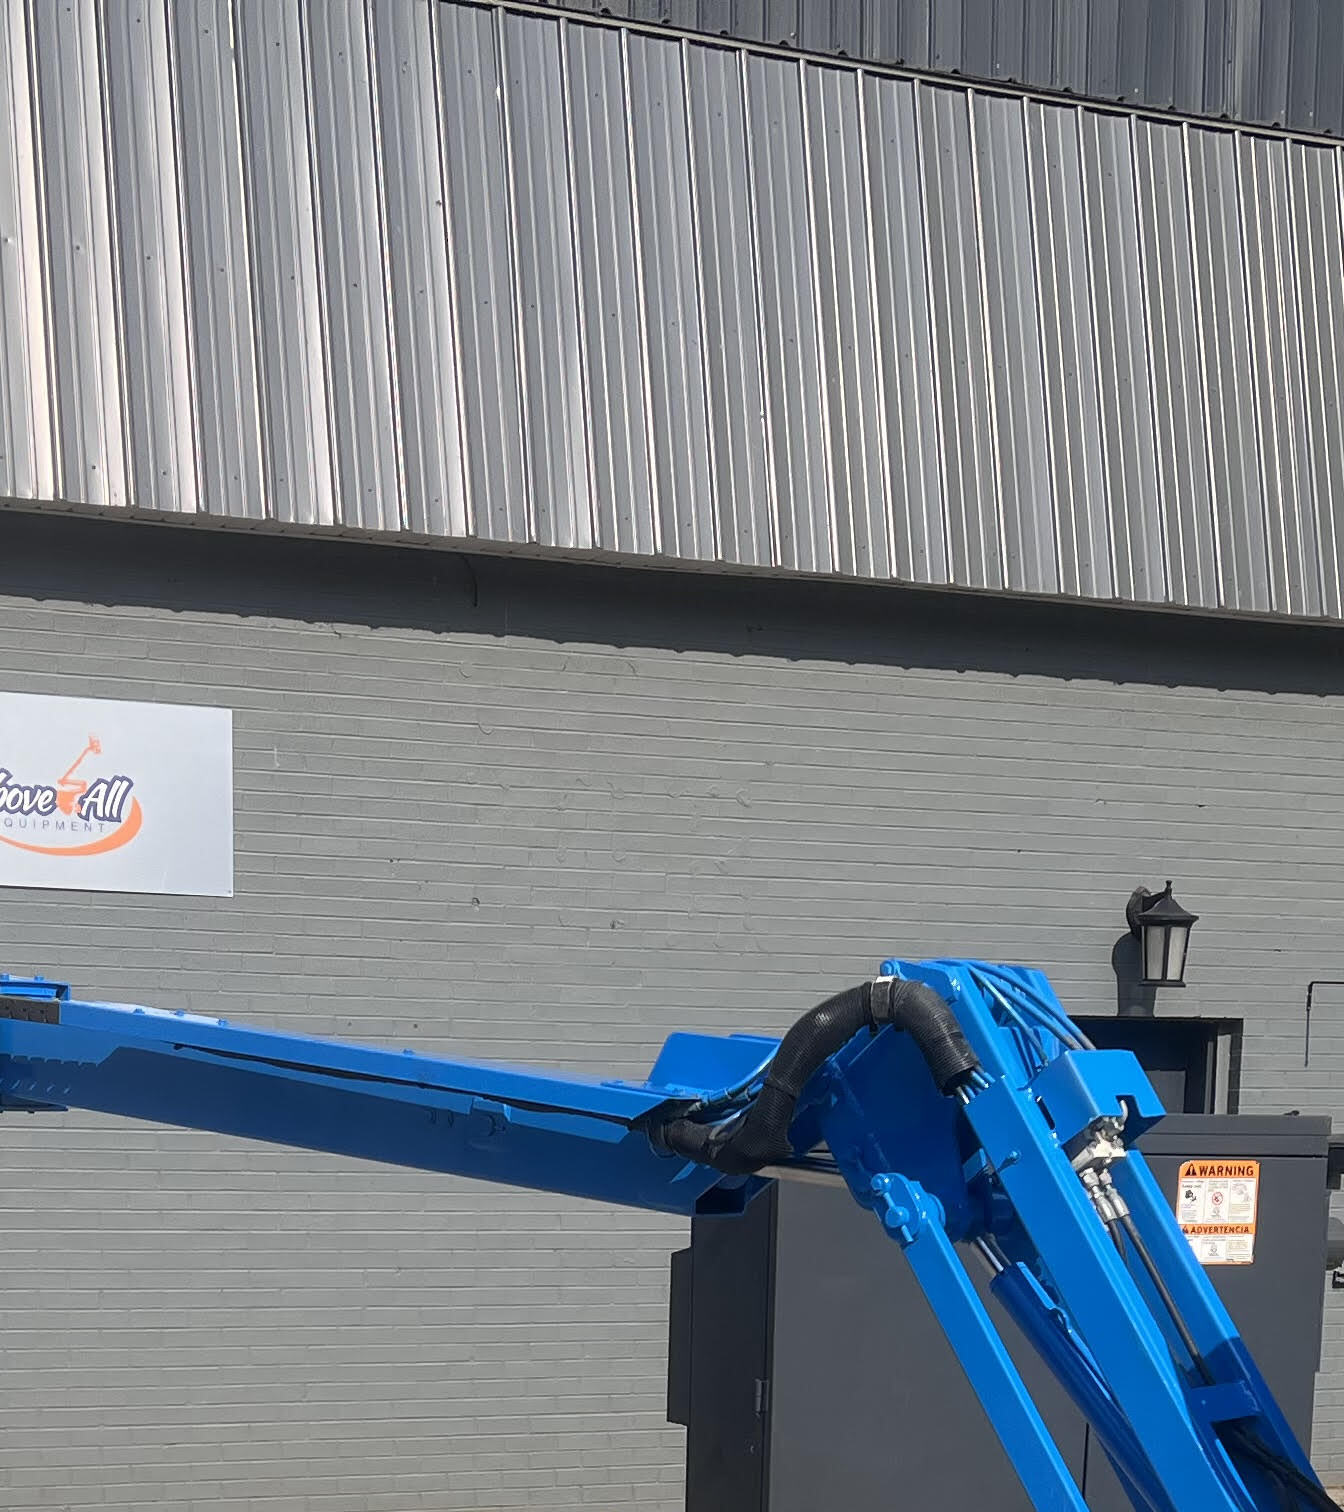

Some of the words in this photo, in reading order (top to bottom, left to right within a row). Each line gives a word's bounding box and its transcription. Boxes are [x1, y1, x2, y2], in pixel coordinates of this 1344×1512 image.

[78, 775, 134, 822] All
[1199, 1165, 1254, 1177] WARNING
[1190, 1225, 1250, 1234] ADVERTENCIA
